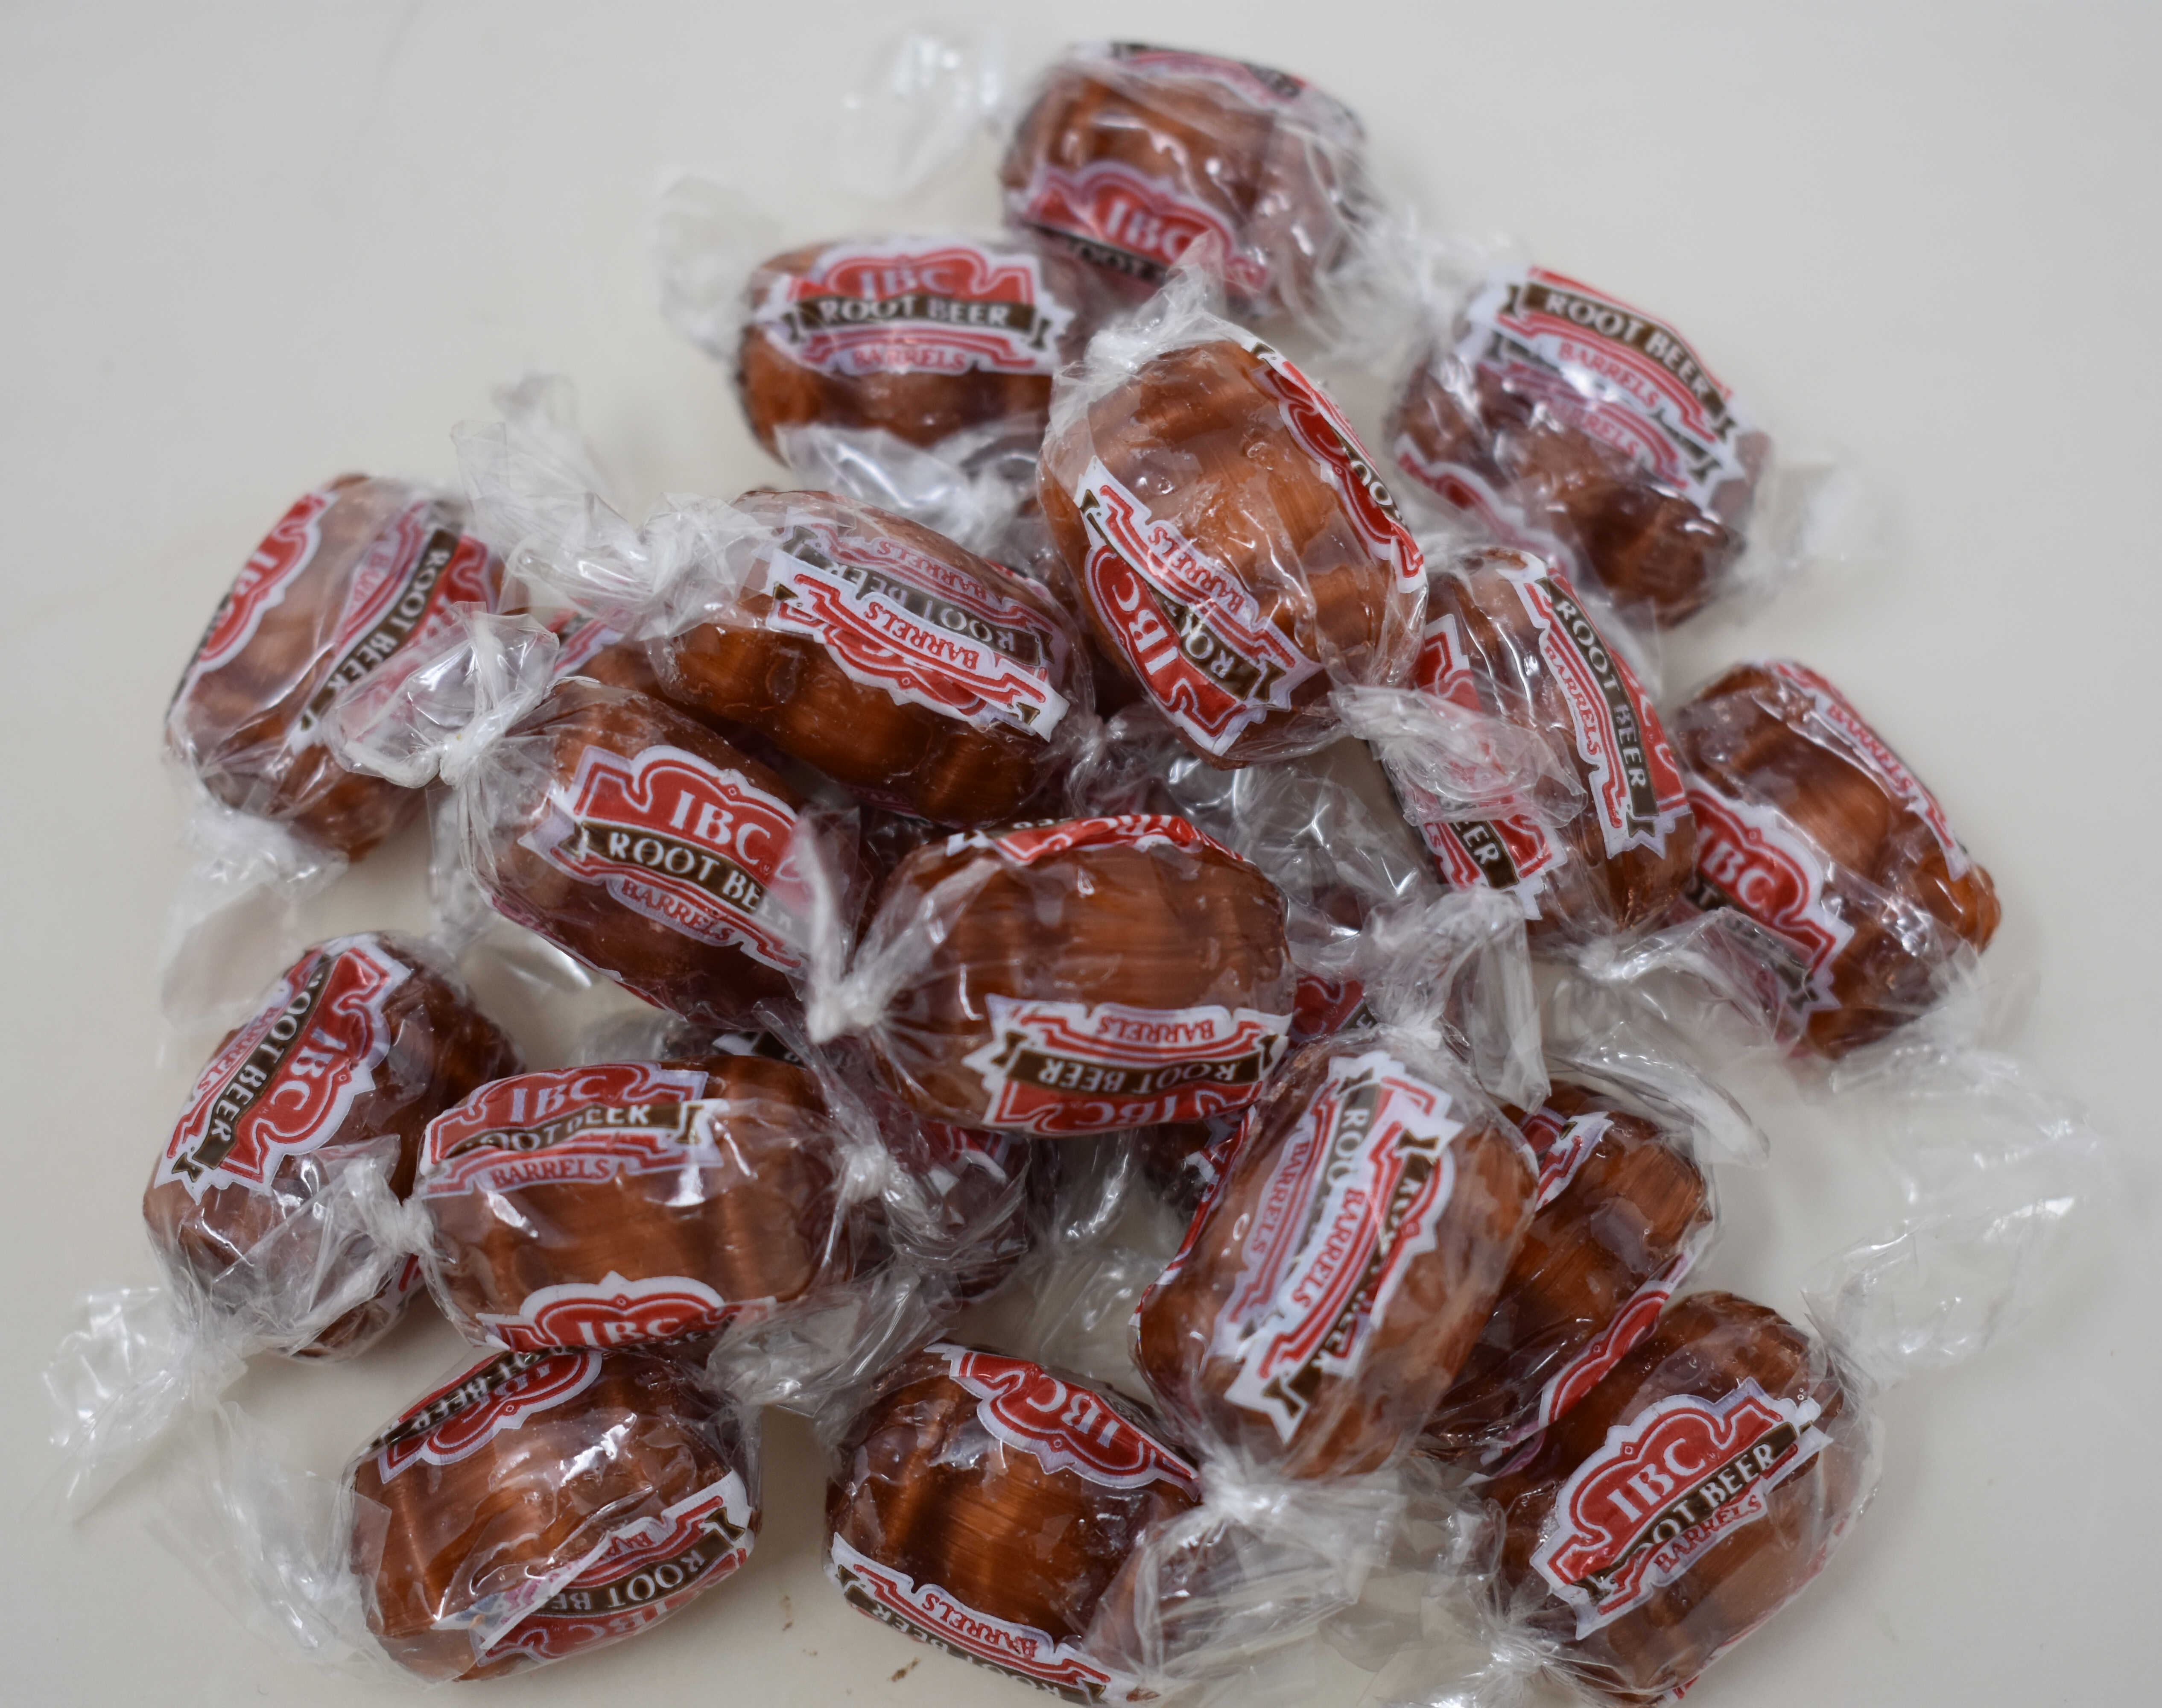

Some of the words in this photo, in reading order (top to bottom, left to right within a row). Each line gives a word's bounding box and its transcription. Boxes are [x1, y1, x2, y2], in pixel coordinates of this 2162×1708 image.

[817, 295, 917, 326] ROOT
[927, 300, 1011, 328] BEER
[859, 265, 959, 301] IBC
[851, 346, 967, 369] BARRELS
[1544, 292, 1645, 342] ROOT
[1644, 330, 1709, 397] BEER
[1558, 341, 1659, 408] BARRELS
[389, 549, 451, 632] ROOT
[876, 541, 987, 602] BARRELS
[1148, 526, 1245, 614] BARRELS
[863, 601, 980, 670] BARRELS
[1111, 571, 1178, 676] IBC
[1543, 646, 1603, 756] BARRELS
[1556, 600, 1621, 692] ROOT
[1613, 704, 1646, 787] BEER
[608, 831, 720, 882] ROOT
[669, 789, 771, 865] IBC
[620, 877, 735, 942] BARRELS
[1097, 1015, 1215, 1043] BARRELS
[270, 1026, 348, 1111] IBC
[509, 1075, 607, 1123] IBC
[1038, 1057, 1127, 1094] BEER
[1130, 1063, 1238, 1095] ROOT
[211, 1064, 268, 1142] BEER
[1074, 1094, 1178, 1126] IBC
[489, 1157, 611, 1186] BARRELS
[1250, 1141, 1310, 1254] BARRELS
[1291, 1187, 1366, 1308] BARRELS
[577, 1318, 685, 1347] IBC
[1025, 1372, 1121, 1449] IBC
[1606, 1437, 1706, 1524] IBC
[1699, 1443, 1775, 1509] BEER
[1653, 1493, 1763, 1574] BARRELS
[607, 1549, 707, 1609] ROOT
[920, 1593, 1040, 1660] BARRELS
